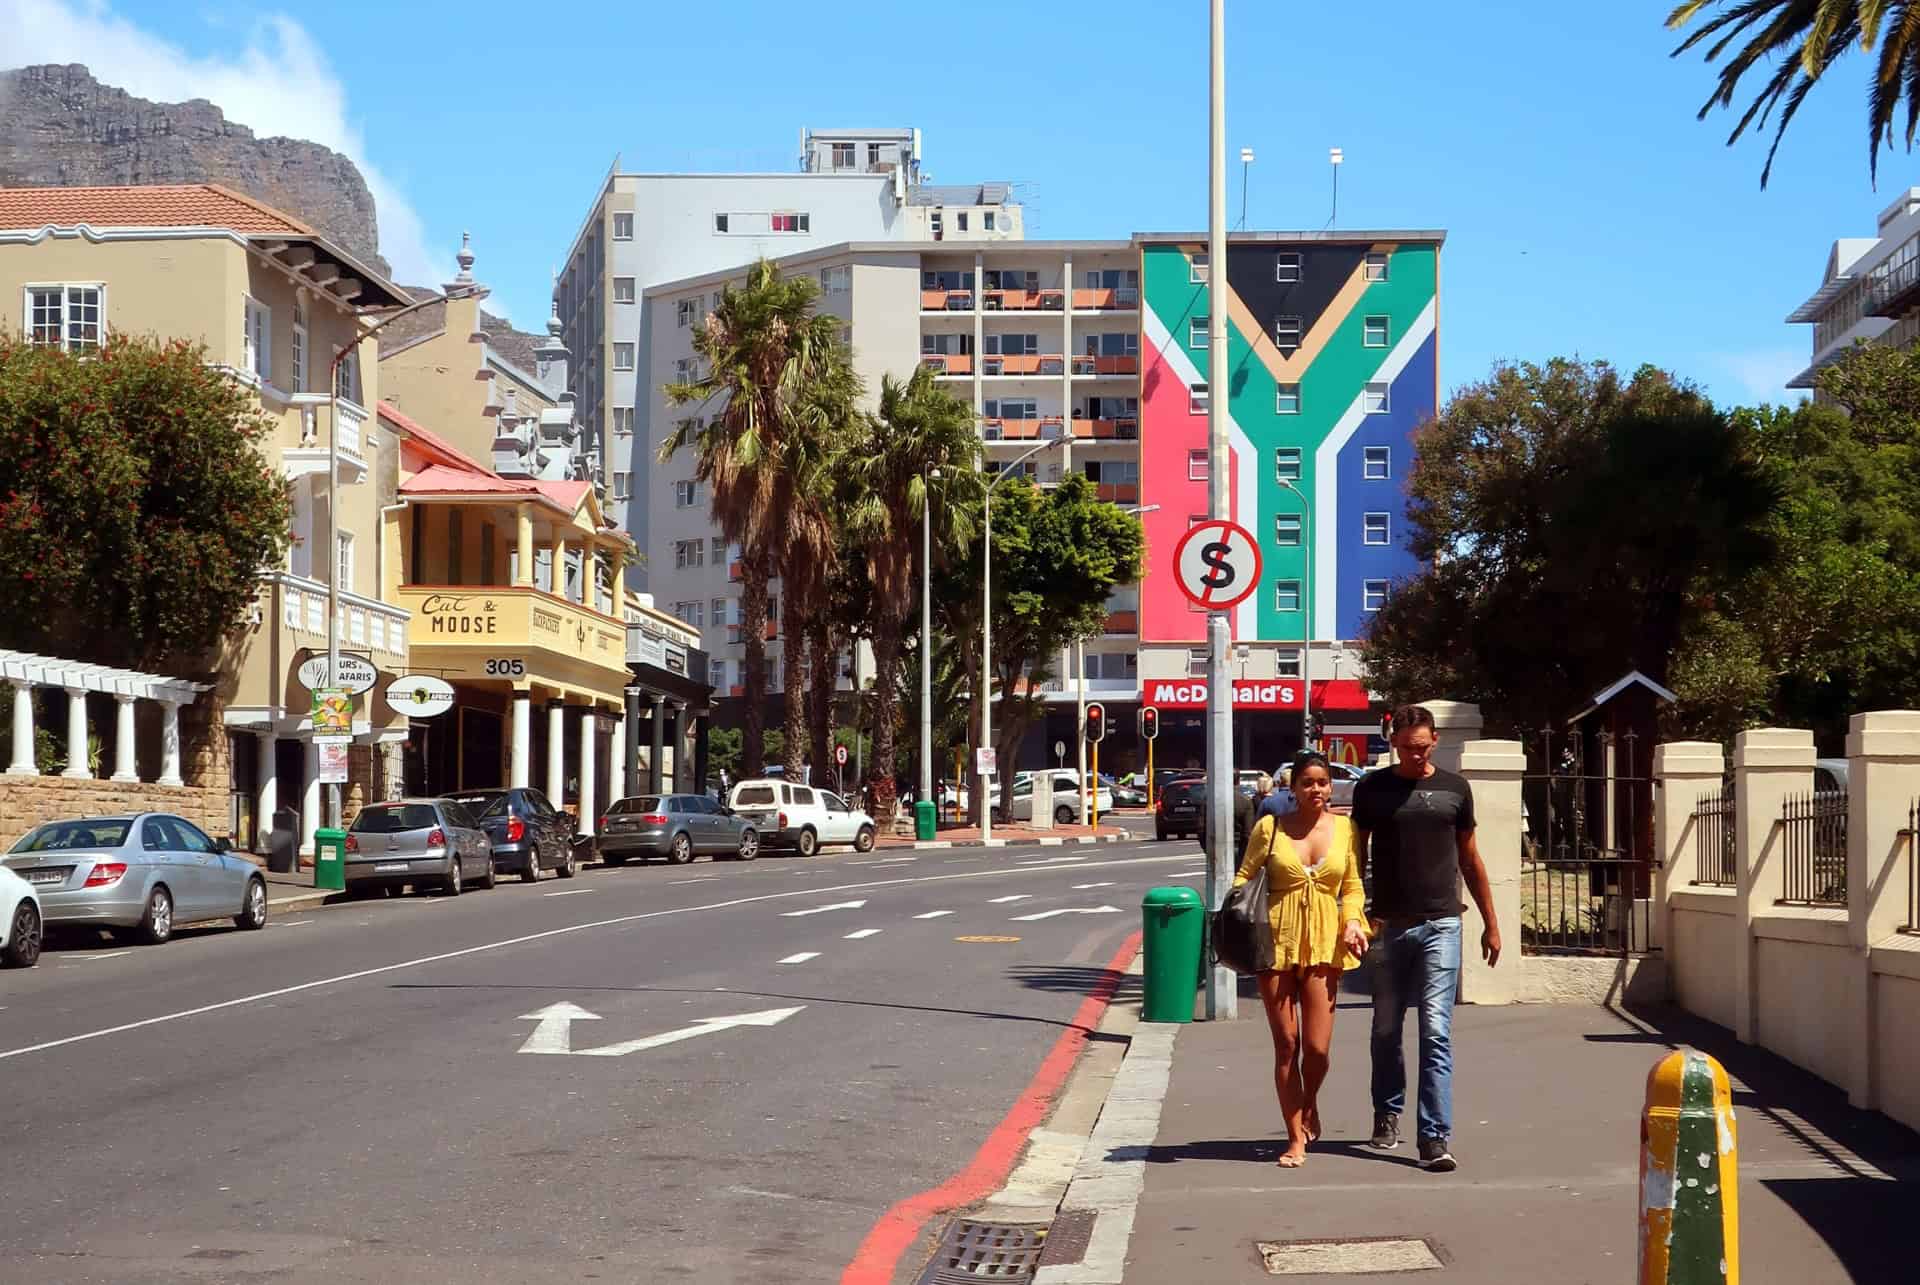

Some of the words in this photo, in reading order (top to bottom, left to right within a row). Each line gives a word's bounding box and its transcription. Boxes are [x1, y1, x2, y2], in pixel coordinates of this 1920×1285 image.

[1200, 542, 1236, 589] S
[422, 594, 471, 615] Cat
[483, 600, 497, 612] &
[432, 616, 497, 633] MOOSE
[339, 661, 357, 669] URS
[486, 659, 524, 675] 305
[339, 673, 372, 681] AFARIS
[1154, 685, 1294, 703] McDald's
